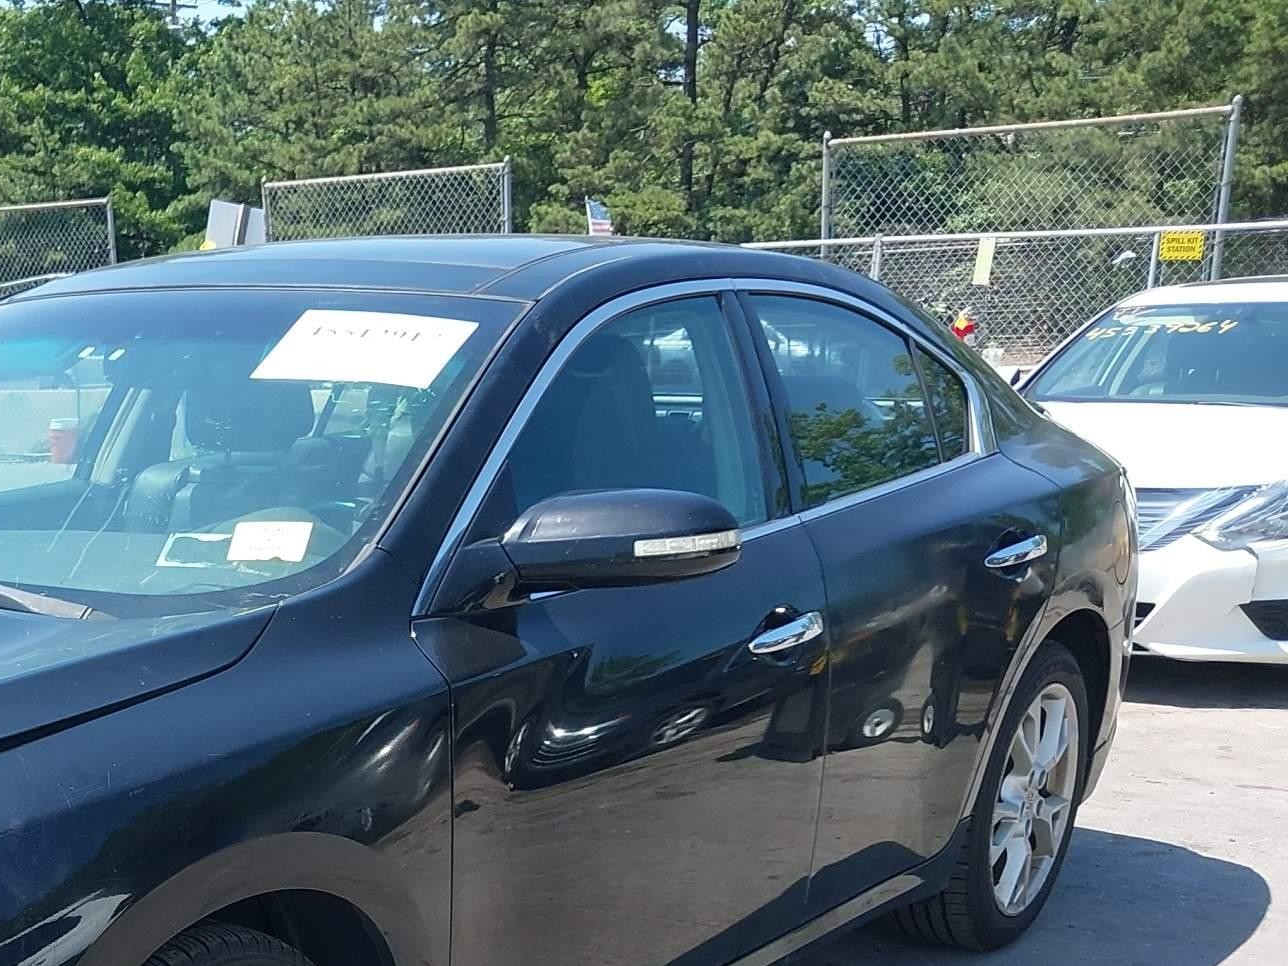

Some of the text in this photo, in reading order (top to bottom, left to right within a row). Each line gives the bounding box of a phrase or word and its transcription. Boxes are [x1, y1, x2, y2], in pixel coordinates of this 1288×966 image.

[1166, 237, 1199, 245] SPILL KIT
[1166, 245, 1196, 253] STATION
